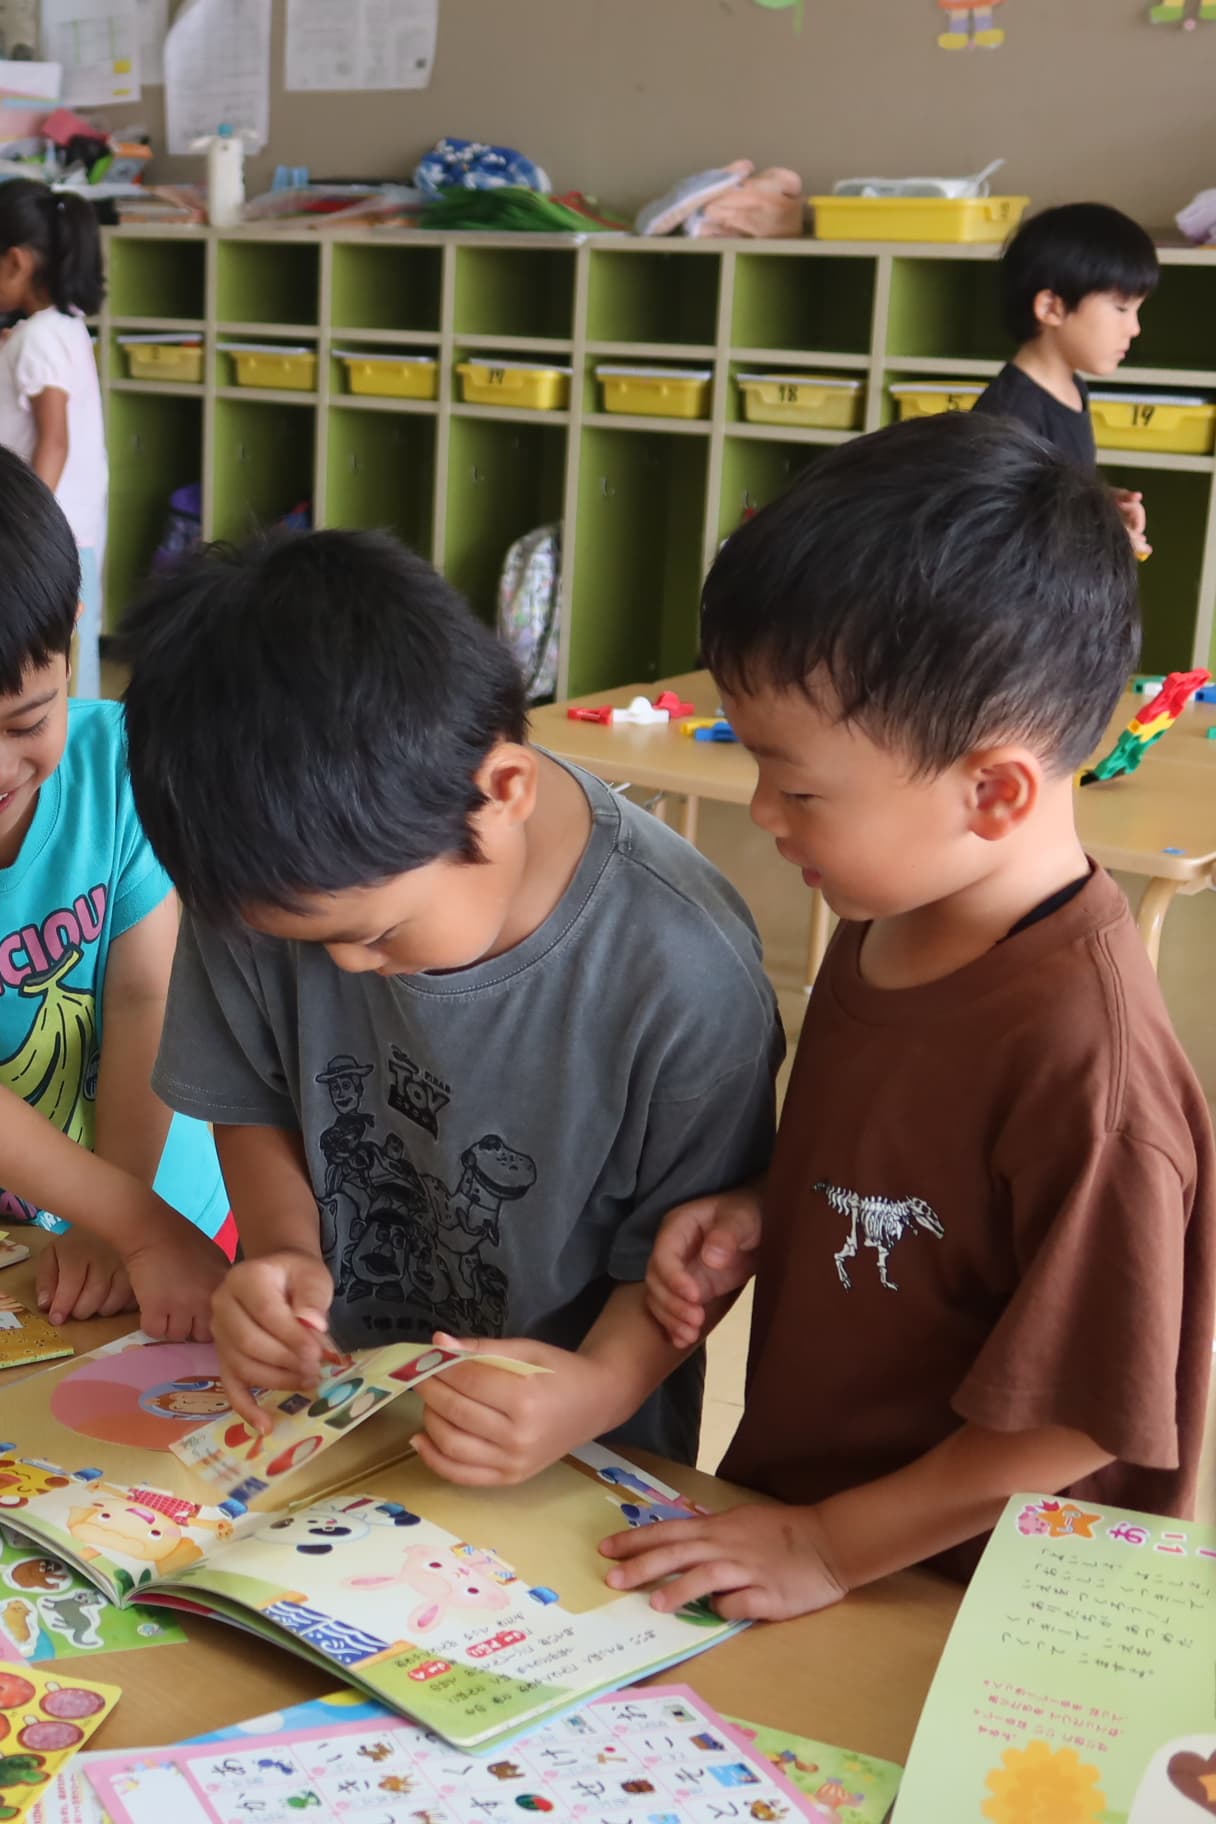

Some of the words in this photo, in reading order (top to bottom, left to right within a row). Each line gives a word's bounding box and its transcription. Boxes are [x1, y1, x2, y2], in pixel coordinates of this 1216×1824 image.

[316, 1742, 344, 1763] い
[644, 1737, 675, 1751] こ
[211, 1757, 248, 1776] あ
[540, 1748, 580, 1768] け
[441, 1764, 476, 1777] く
[675, 1767, 705, 1786] そ
[337, 1778, 371, 1795] き
[570, 1779, 606, 1800] せ
[237, 1792, 267, 1813] か
[469, 1796, 503, 1815] す
[707, 1800, 740, 1820] と
